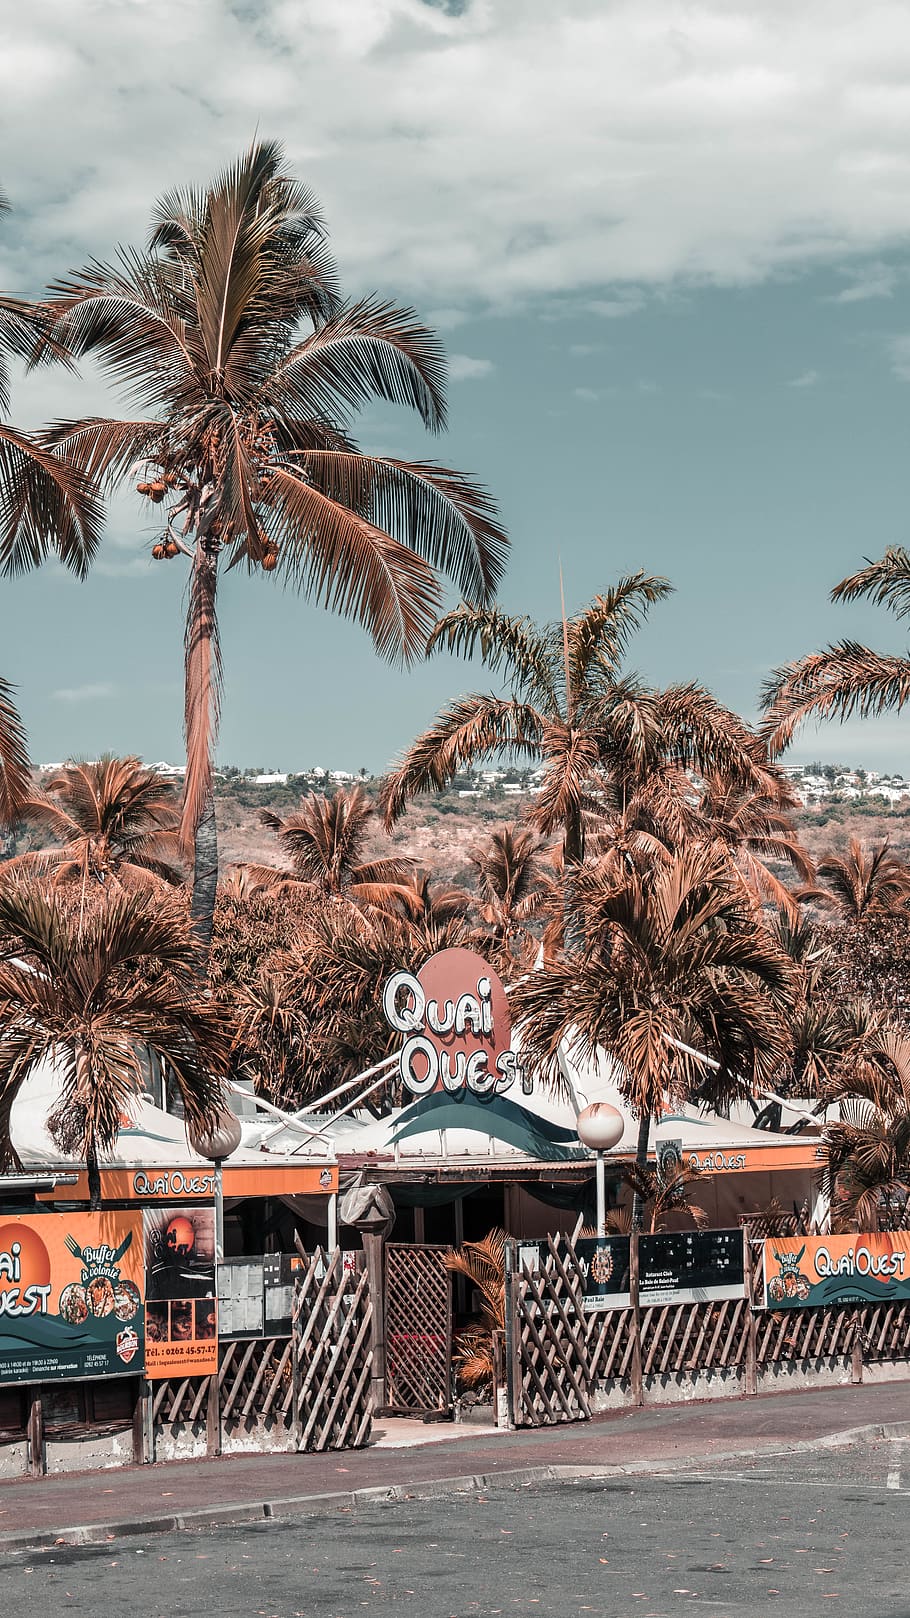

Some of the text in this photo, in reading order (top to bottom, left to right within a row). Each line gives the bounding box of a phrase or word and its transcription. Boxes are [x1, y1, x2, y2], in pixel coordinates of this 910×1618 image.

[83, 1245, 116, 1264] Buffet
[82, 1264, 120, 1281] à volonté
[166, 1347, 184, 1355] 0262
